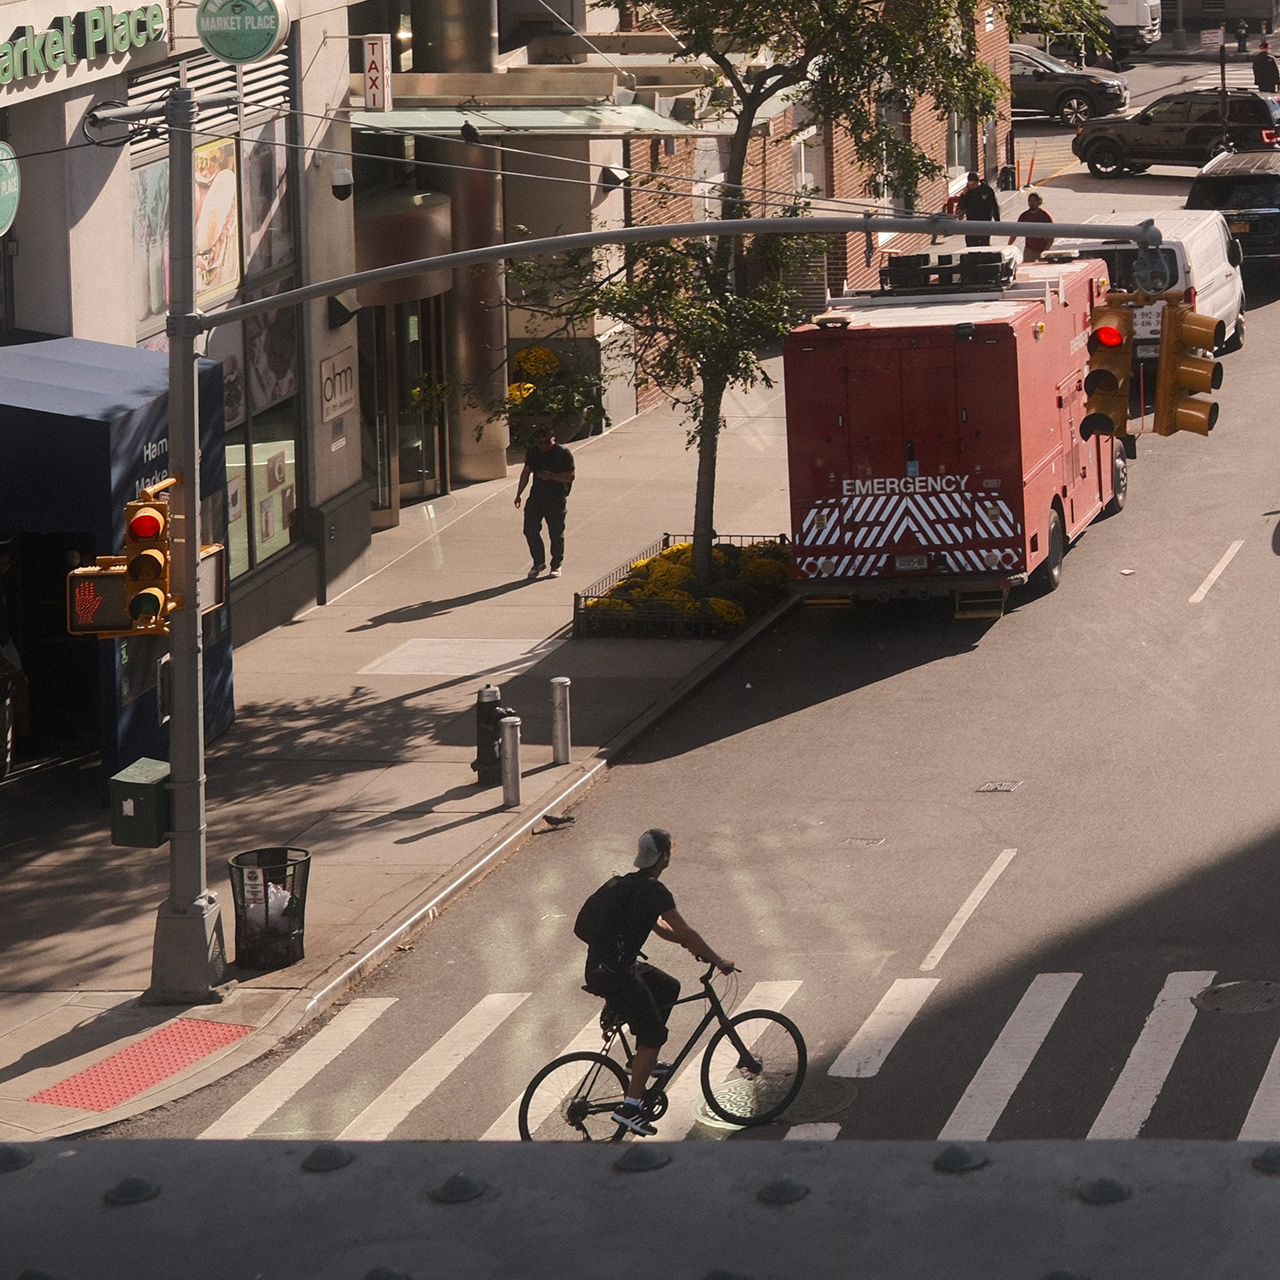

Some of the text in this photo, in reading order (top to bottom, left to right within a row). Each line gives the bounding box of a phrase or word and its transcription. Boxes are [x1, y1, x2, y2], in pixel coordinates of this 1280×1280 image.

[85, 3, 164, 60] Place
[200, 15, 276, 32] MARKET PLACE
[367, 42, 379, 106] TAXI
[324, 362, 353, 402] ohm
[842, 474, 970, 496] EMERGENCY
